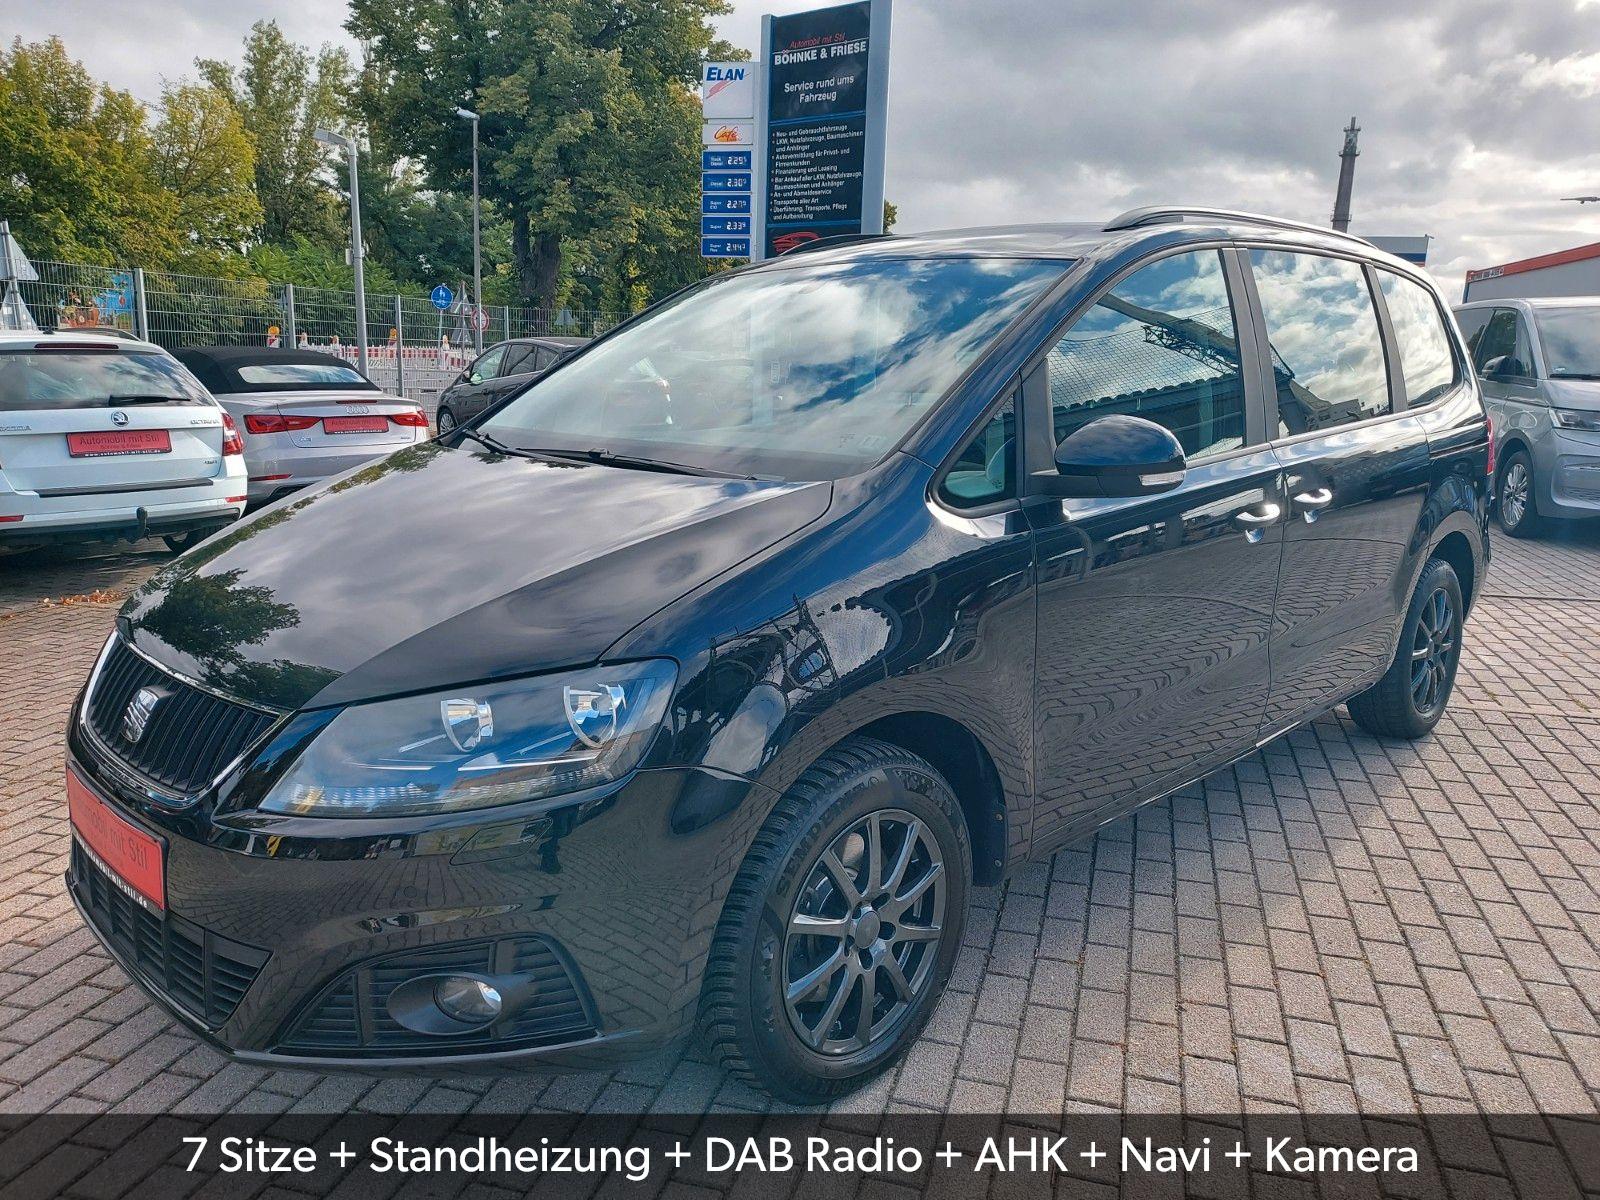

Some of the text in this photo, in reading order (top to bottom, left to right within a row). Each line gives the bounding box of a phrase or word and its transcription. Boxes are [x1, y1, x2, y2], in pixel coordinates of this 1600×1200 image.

[820, 48, 828, 58] &
[831, 41, 867, 58] FRIESE
[706, 67, 745, 81] ELAN
[784, 75, 855, 93] Service rund ums
[799, 91, 837, 103] Fahrzeug
[80, 435, 125, 444] Automobil
[146, 434, 159, 442] Stil
[128, 838, 148, 870] Stil
